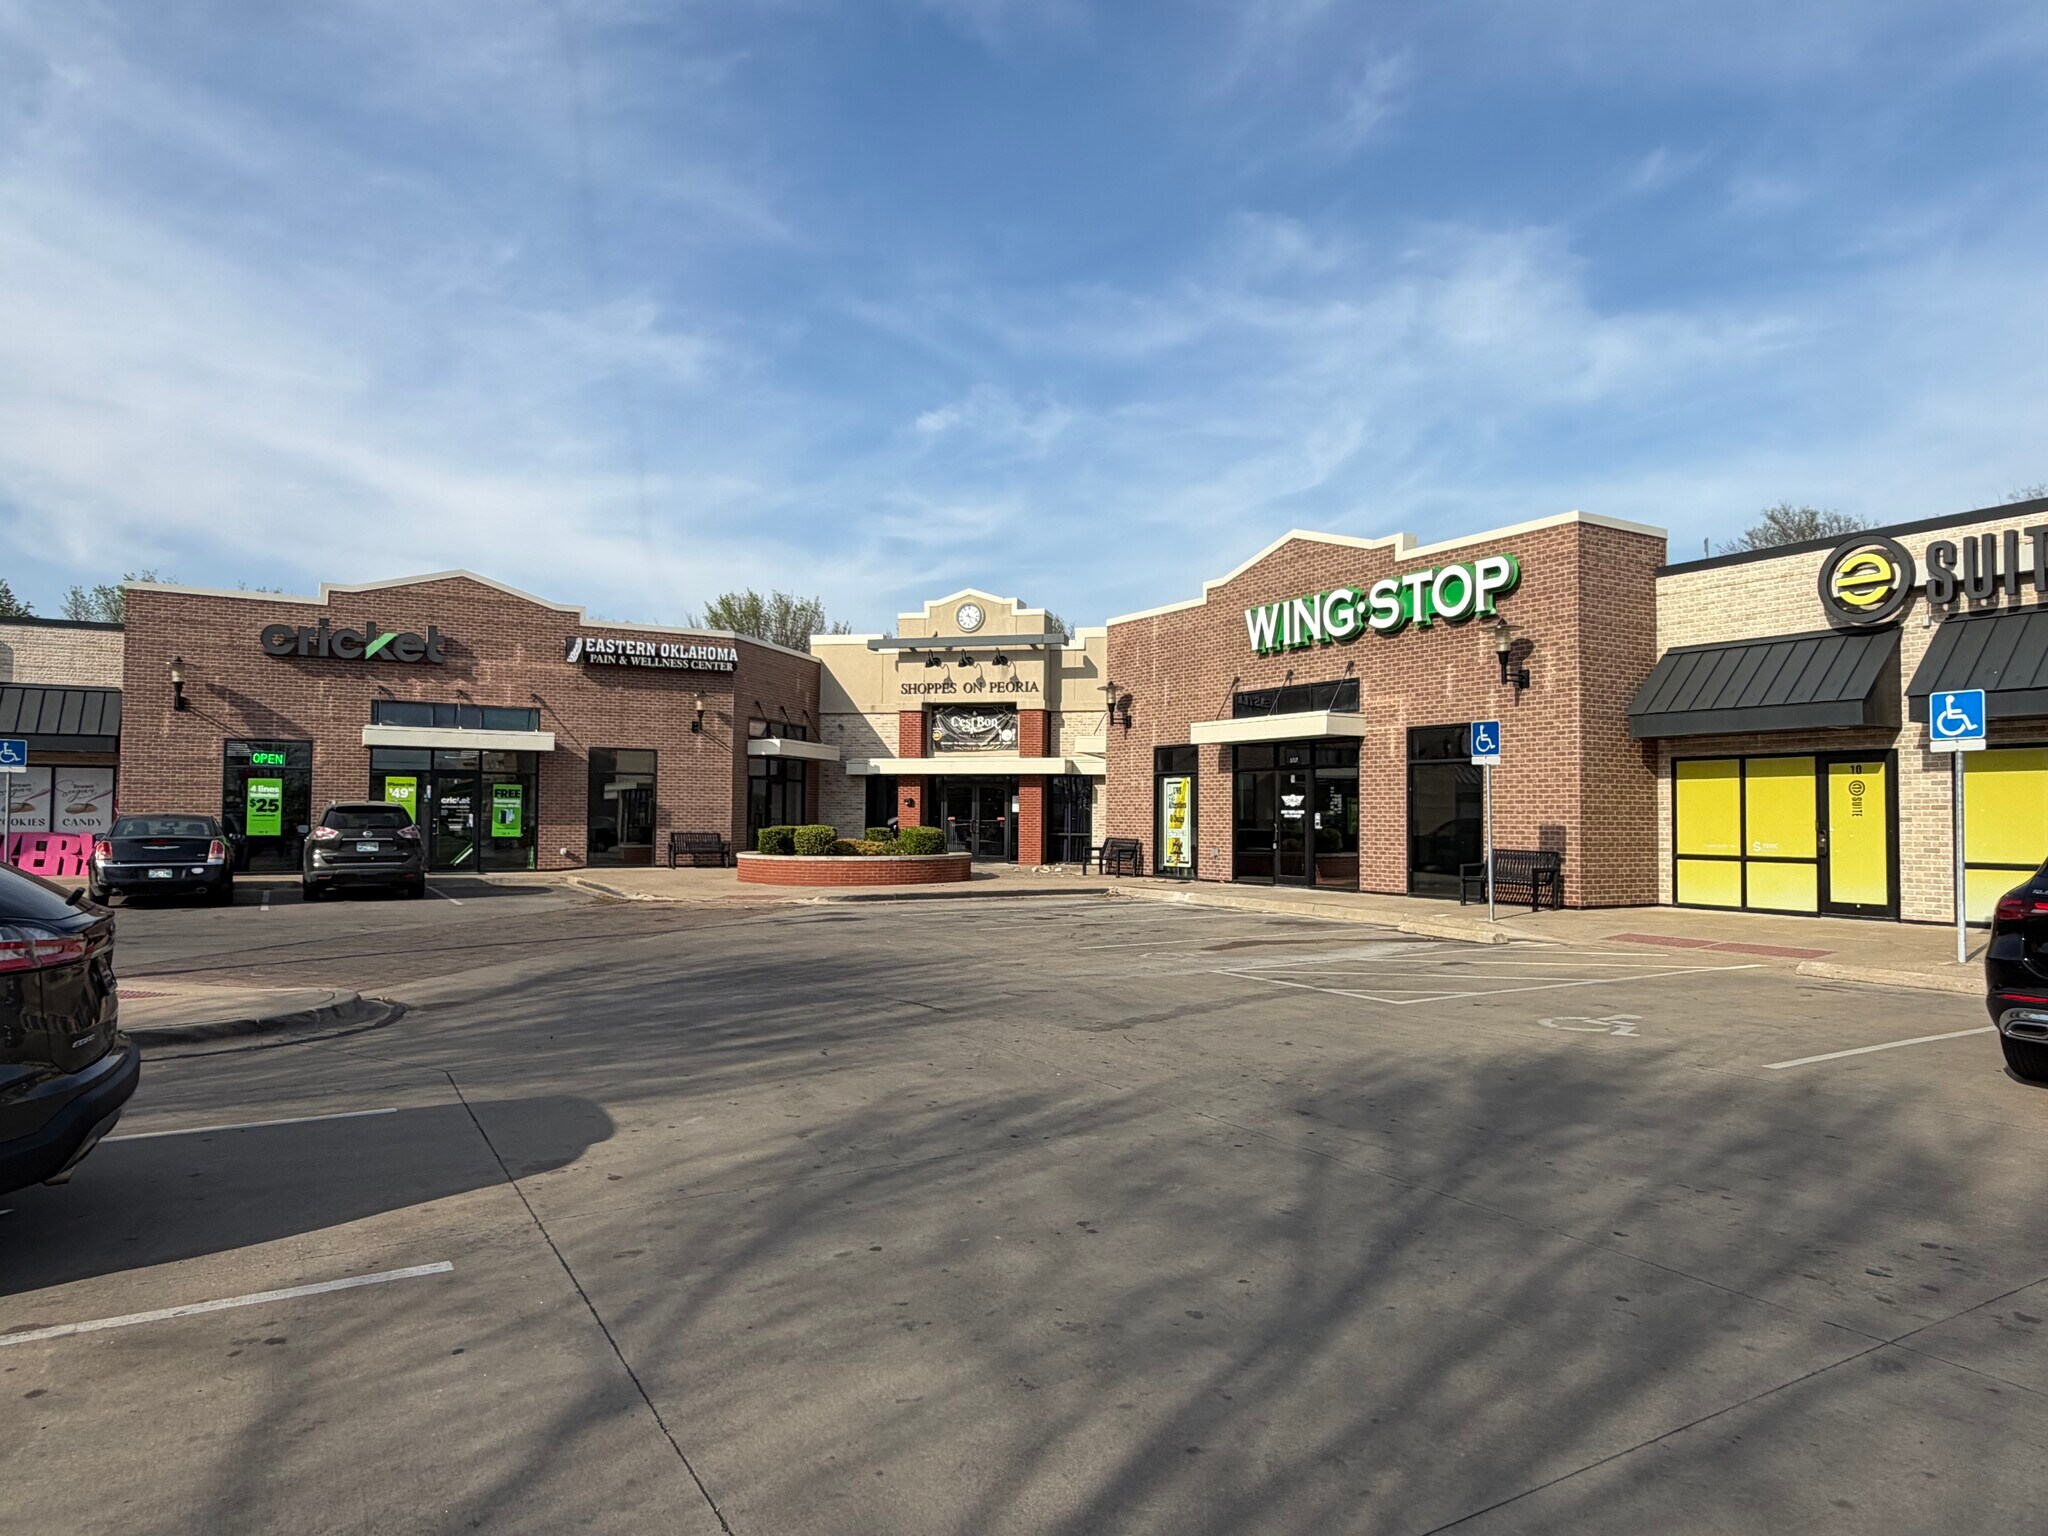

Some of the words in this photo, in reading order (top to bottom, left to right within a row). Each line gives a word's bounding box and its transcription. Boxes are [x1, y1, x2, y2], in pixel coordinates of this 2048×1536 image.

[260, 617, 446, 663] cricket
[585, 637, 656, 656] EASTERN
[660, 643, 739, 662] OKLAHOMA
[590, 653, 617, 664] PAIN
[619, 656, 628, 665] &
[630, 655, 689, 669] WELLNESS
[690, 660, 734, 671] CENTER
[900, 682, 957, 695] SHOPPES
[963, 681, 984, 694] ON
[989, 680, 1039, 693] PEORIA
[252, 752, 283, 765] OPEN
[1850, 764, 1862, 774] 10
[494, 789, 521, 798] FREE
[249, 799, 279, 812] $25
[62, 818, 103, 826] CANDY
